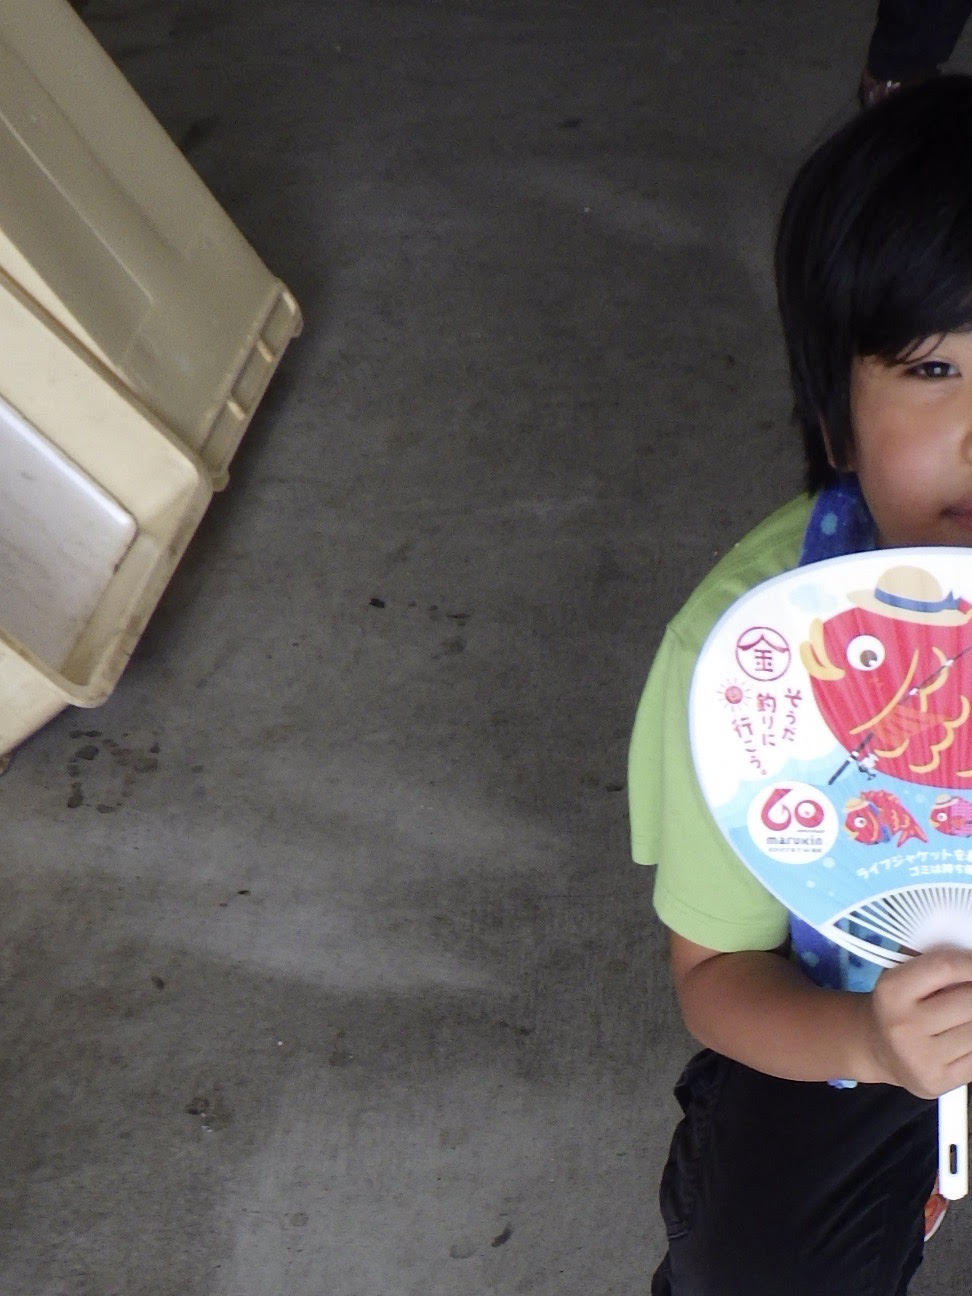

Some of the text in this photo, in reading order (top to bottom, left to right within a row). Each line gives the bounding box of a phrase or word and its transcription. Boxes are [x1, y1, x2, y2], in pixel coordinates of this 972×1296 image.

[757, 693, 777, 746] 釣りに
[760, 788, 825, 831] 60
